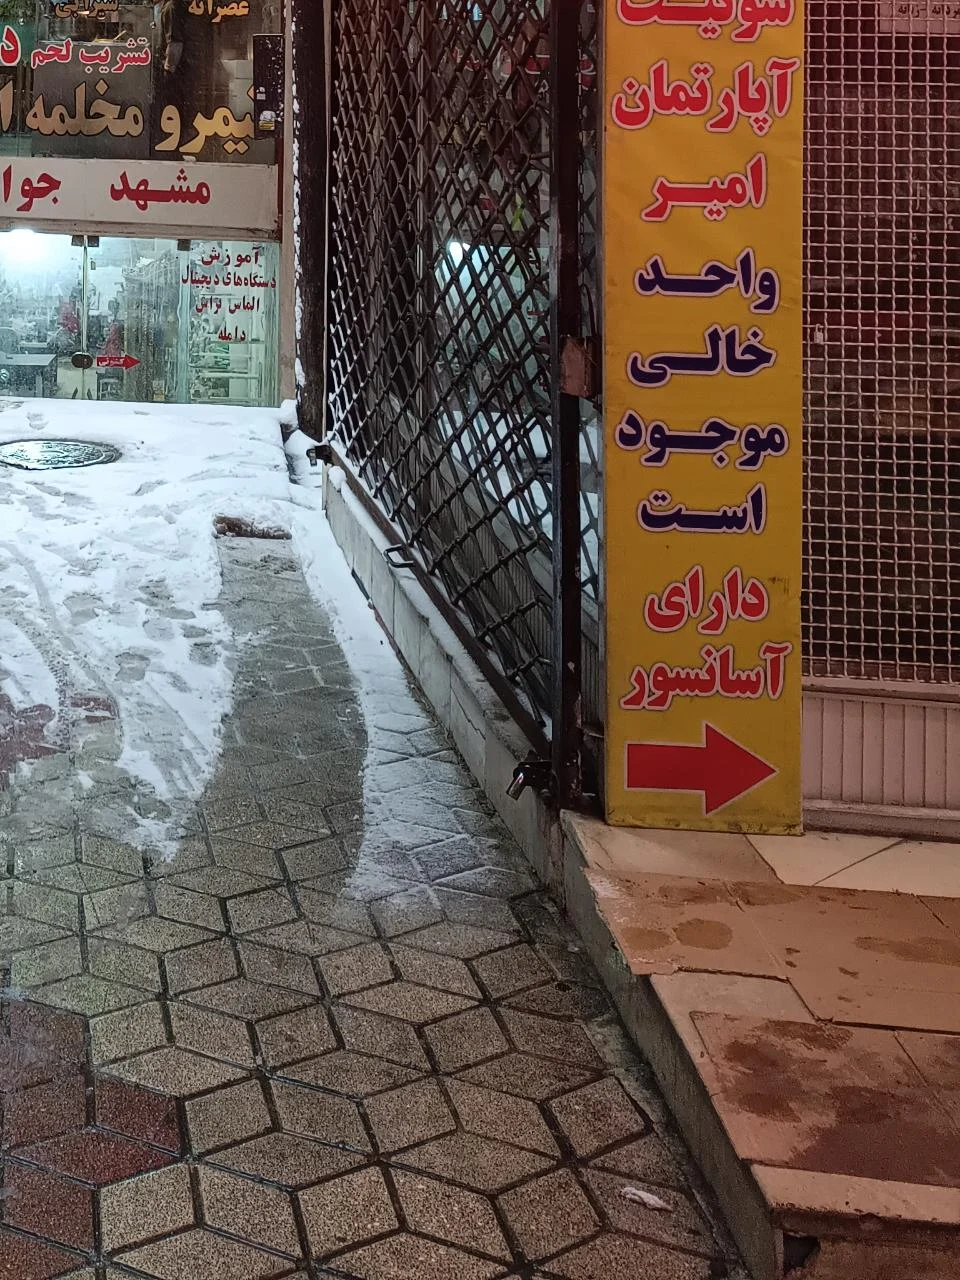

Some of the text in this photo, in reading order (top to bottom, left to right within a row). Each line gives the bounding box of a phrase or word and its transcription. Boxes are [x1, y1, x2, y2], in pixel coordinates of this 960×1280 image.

[31, 38, 151, 73] تشریب لحم
[26, 78, 144, 138] مخلمه
[612, 56, 801, 136] آپارتمان
[109, 168, 211, 211] مشهد
[641, 152, 768, 221] امیر
[201, 245, 261, 267] آموزش
[635, 247, 780, 314] واحد
[228, 295, 260, 314] الماس
[626, 322, 777, 388] خالی
[615, 410, 789, 470] موجود
[637, 482, 768, 535] است
[644, 565, 770, 635] دارای
[620, 641, 794, 711] آسانسور
